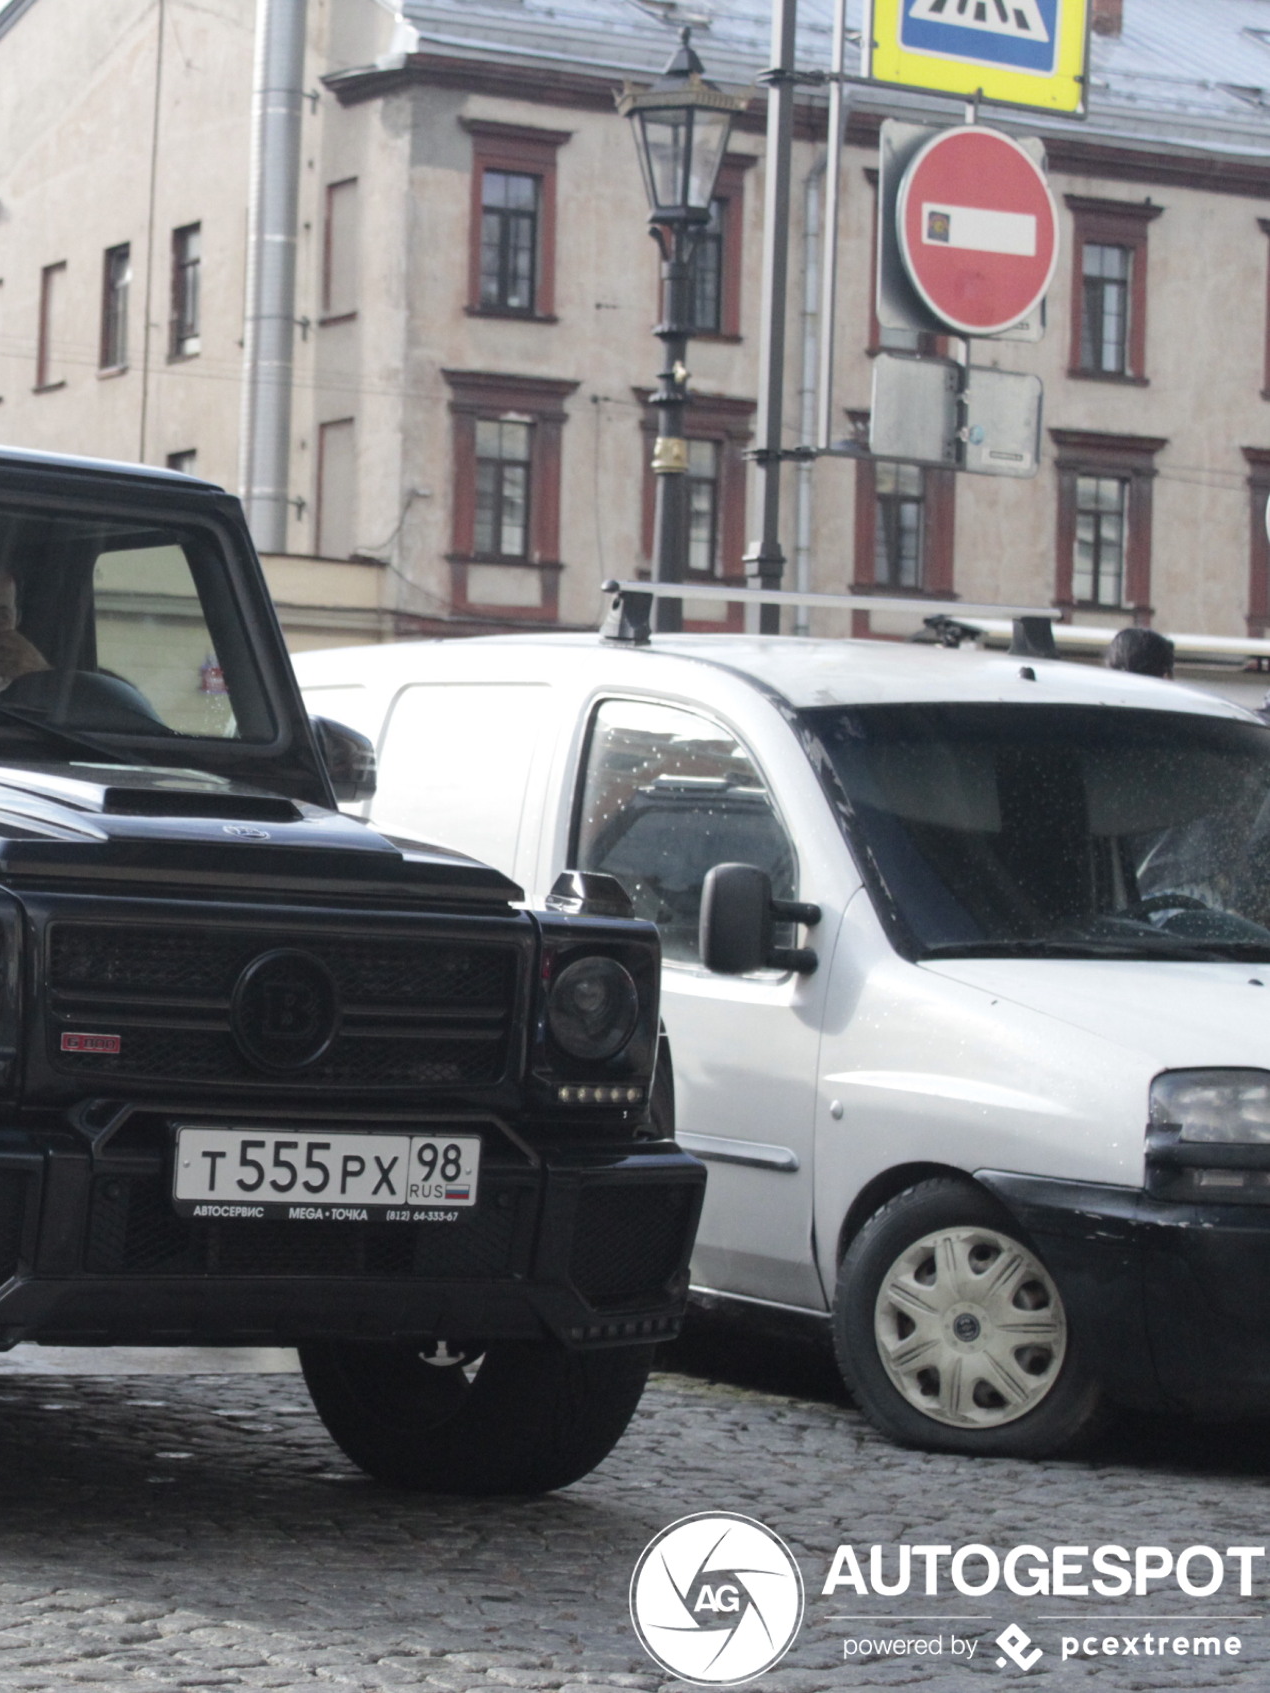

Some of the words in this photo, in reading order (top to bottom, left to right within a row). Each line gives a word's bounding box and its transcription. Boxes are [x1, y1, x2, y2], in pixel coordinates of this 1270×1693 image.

[417, 1142, 462, 1183] 98
[409, 1183, 443, 1199] RUS
[386, 1209, 410, 1222] (812)
